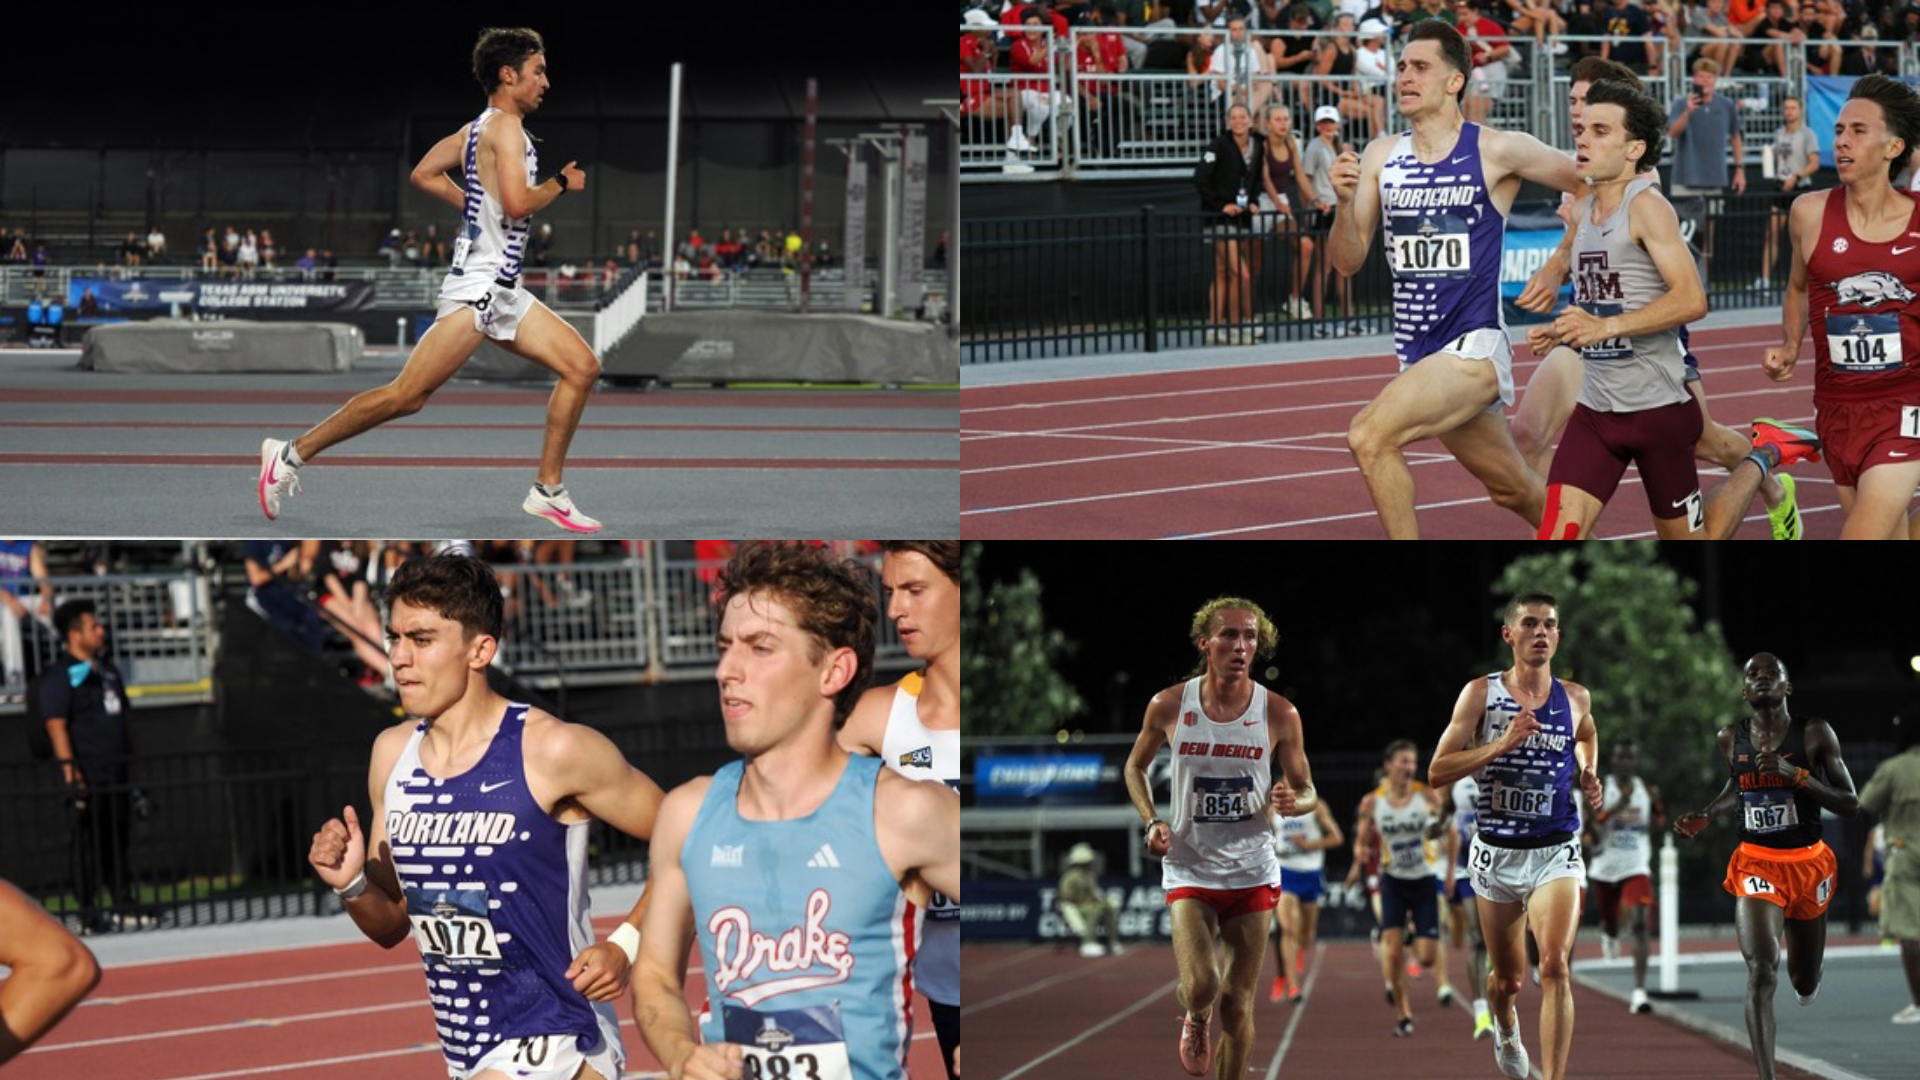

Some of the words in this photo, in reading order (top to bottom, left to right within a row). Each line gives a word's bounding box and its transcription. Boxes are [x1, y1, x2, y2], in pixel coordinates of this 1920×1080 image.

[1389, 186, 1475, 208] PORTLAND
[1400, 238, 1462, 268] 1070
[199, 296, 249, 307] COLLEGE
[253, 296, 307, 307] STATION
[1843, 338, 1887, 363] 104
[912, 747, 931, 763] SKY
[1179, 742, 1210, 755] NEW
[1211, 744, 1264, 760] MEXICO
[1205, 796, 1242, 816] 854
[388, 811, 516, 845] PORTLAND
[1754, 808, 1785, 828] 967
[1749, 877, 1770, 893] 14
[421, 920, 492, 956] 1072
[708, 887, 856, 992] Drake
